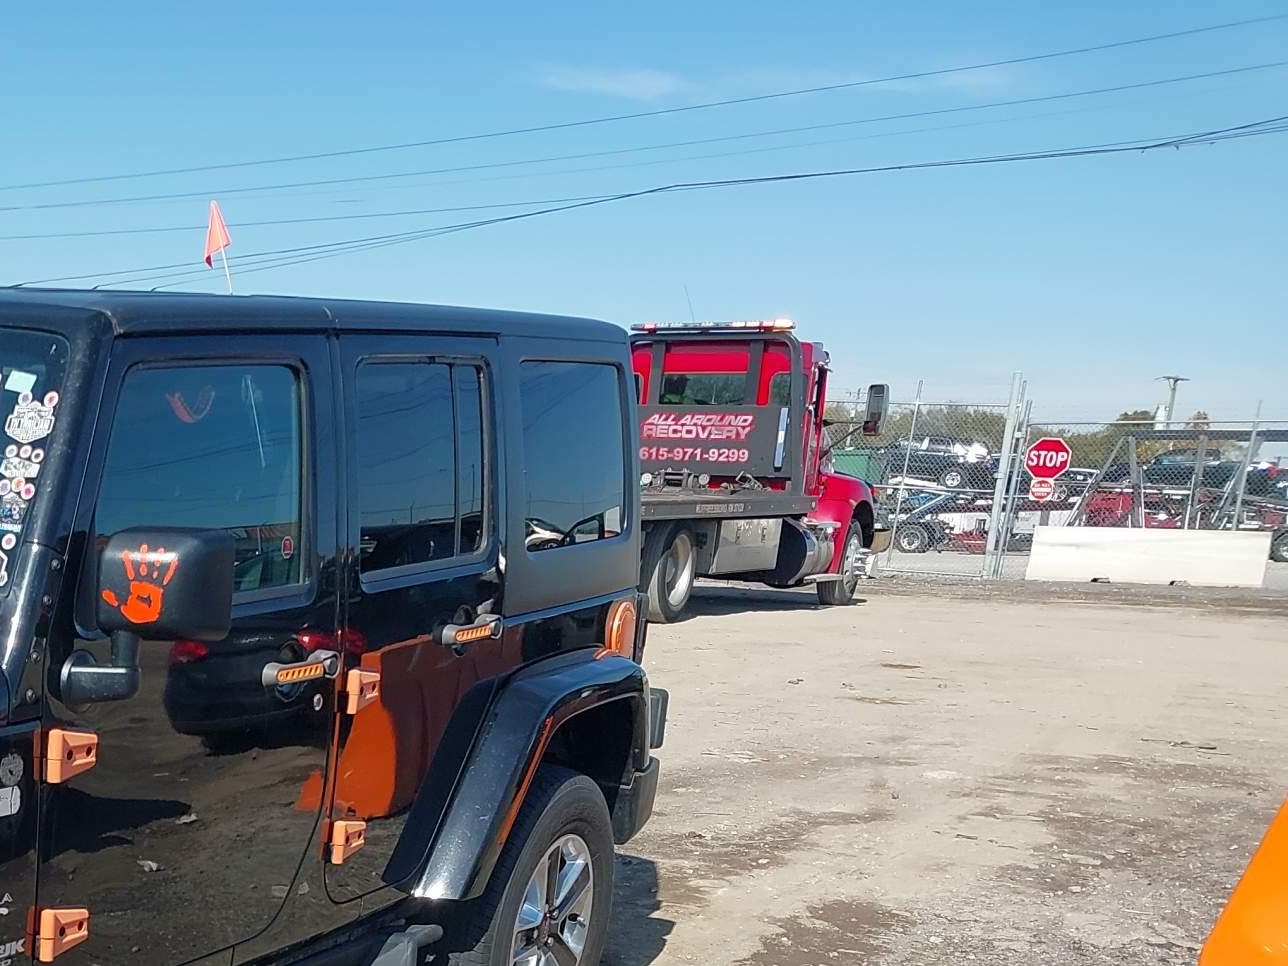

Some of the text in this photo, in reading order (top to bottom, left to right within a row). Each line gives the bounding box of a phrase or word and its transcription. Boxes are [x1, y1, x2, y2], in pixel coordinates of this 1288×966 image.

[645, 413, 753, 426] ALL AROUND
[642, 424, 752, 440] RECOVERY
[639, 446, 749, 462] 615-971-9299
[1027, 449, 1068, 468] STOP
